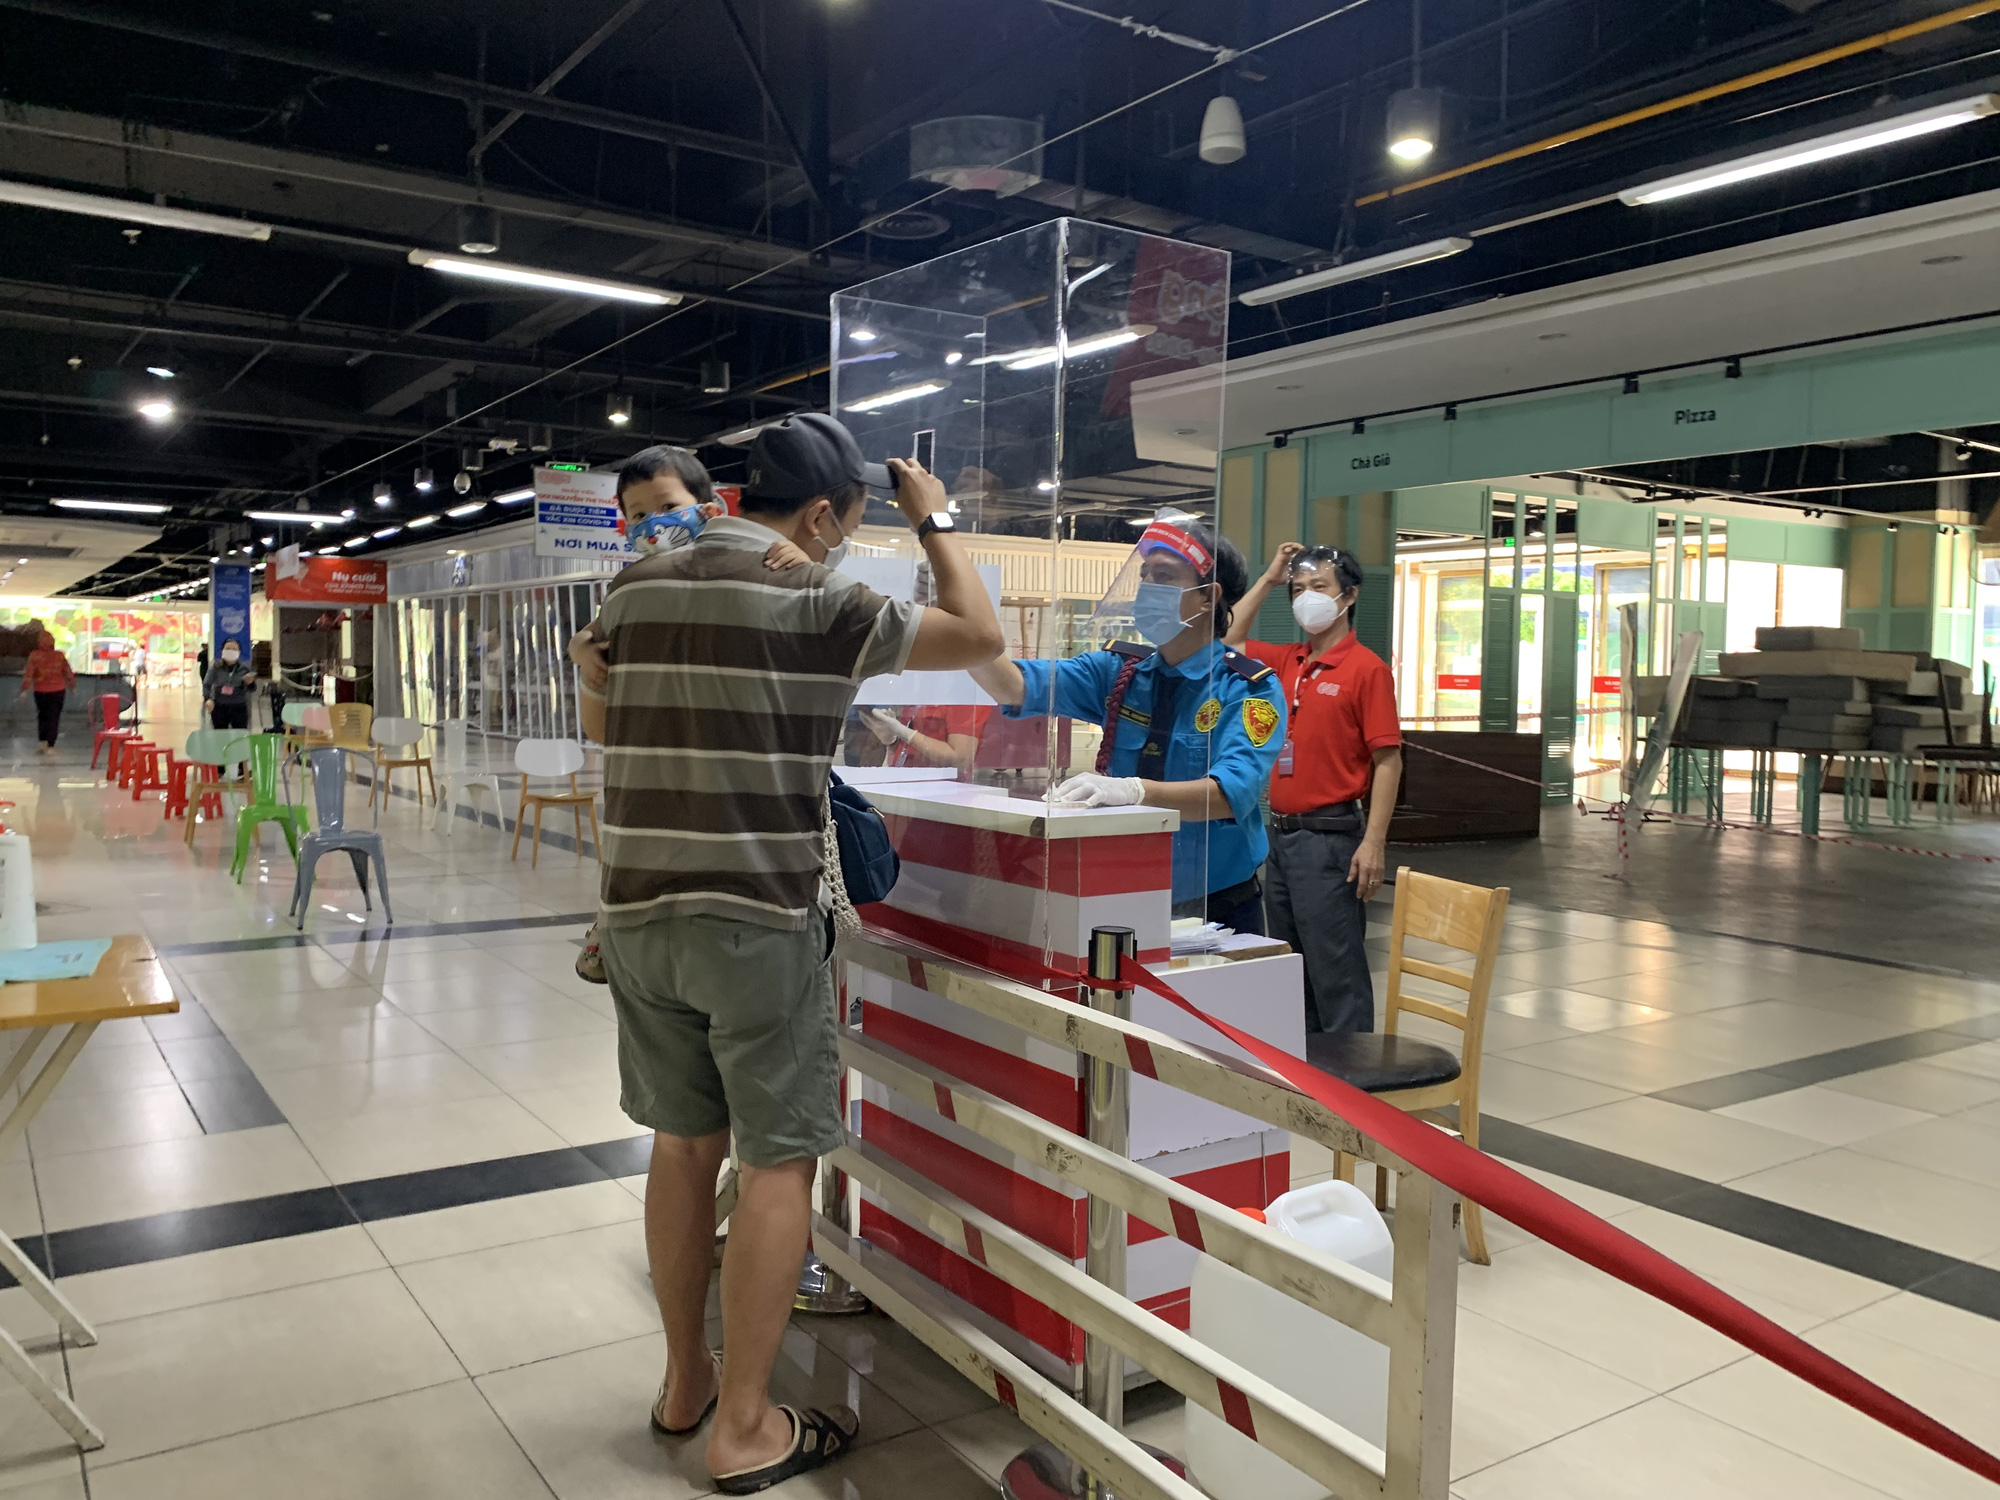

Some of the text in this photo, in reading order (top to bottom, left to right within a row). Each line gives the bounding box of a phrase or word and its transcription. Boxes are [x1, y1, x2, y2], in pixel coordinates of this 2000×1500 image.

[1675, 408, 1716, 425] Pizza
[577, 517, 611, 526] COVID-19
[554, 538, 582, 549] NƠI
[586, 541, 619, 552] MUA
